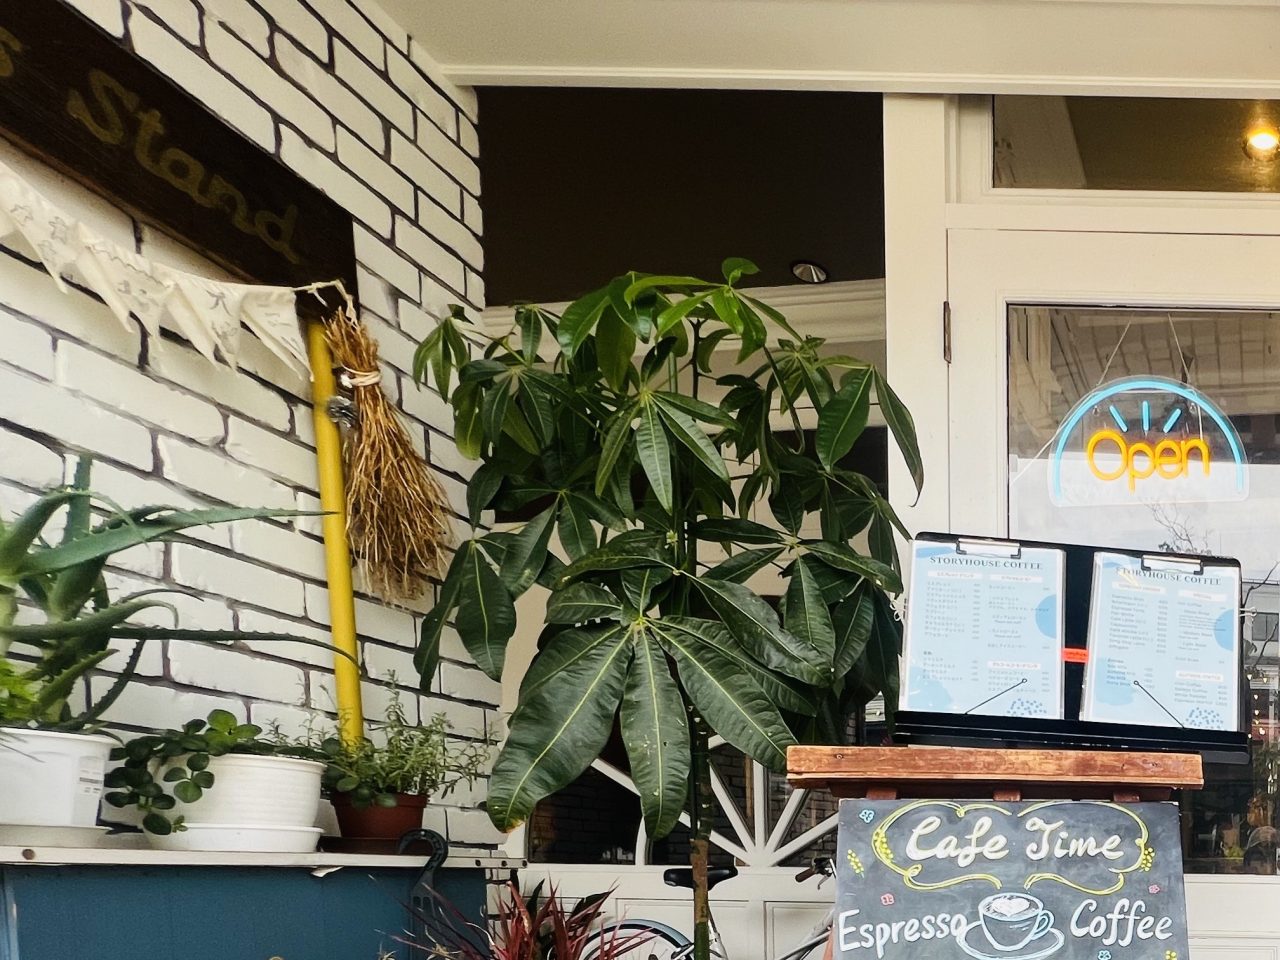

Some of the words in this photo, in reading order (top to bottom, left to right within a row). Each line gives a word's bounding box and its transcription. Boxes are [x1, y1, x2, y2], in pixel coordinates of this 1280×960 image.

[66, 68, 302, 265] Stand
[1086, 429, 1210, 494] Open
[929, 556, 1001, 568] STORYHOUSE
[1003, 559, 1043, 570] COFFEE
[1184, 575, 1222, 586] COFFEE
[905, 814, 1011, 867] Cafe
[1025, 816, 1125, 861] Time
[838, 909, 968, 959] Espresso
[1070, 898, 1173, 947] Coffee
